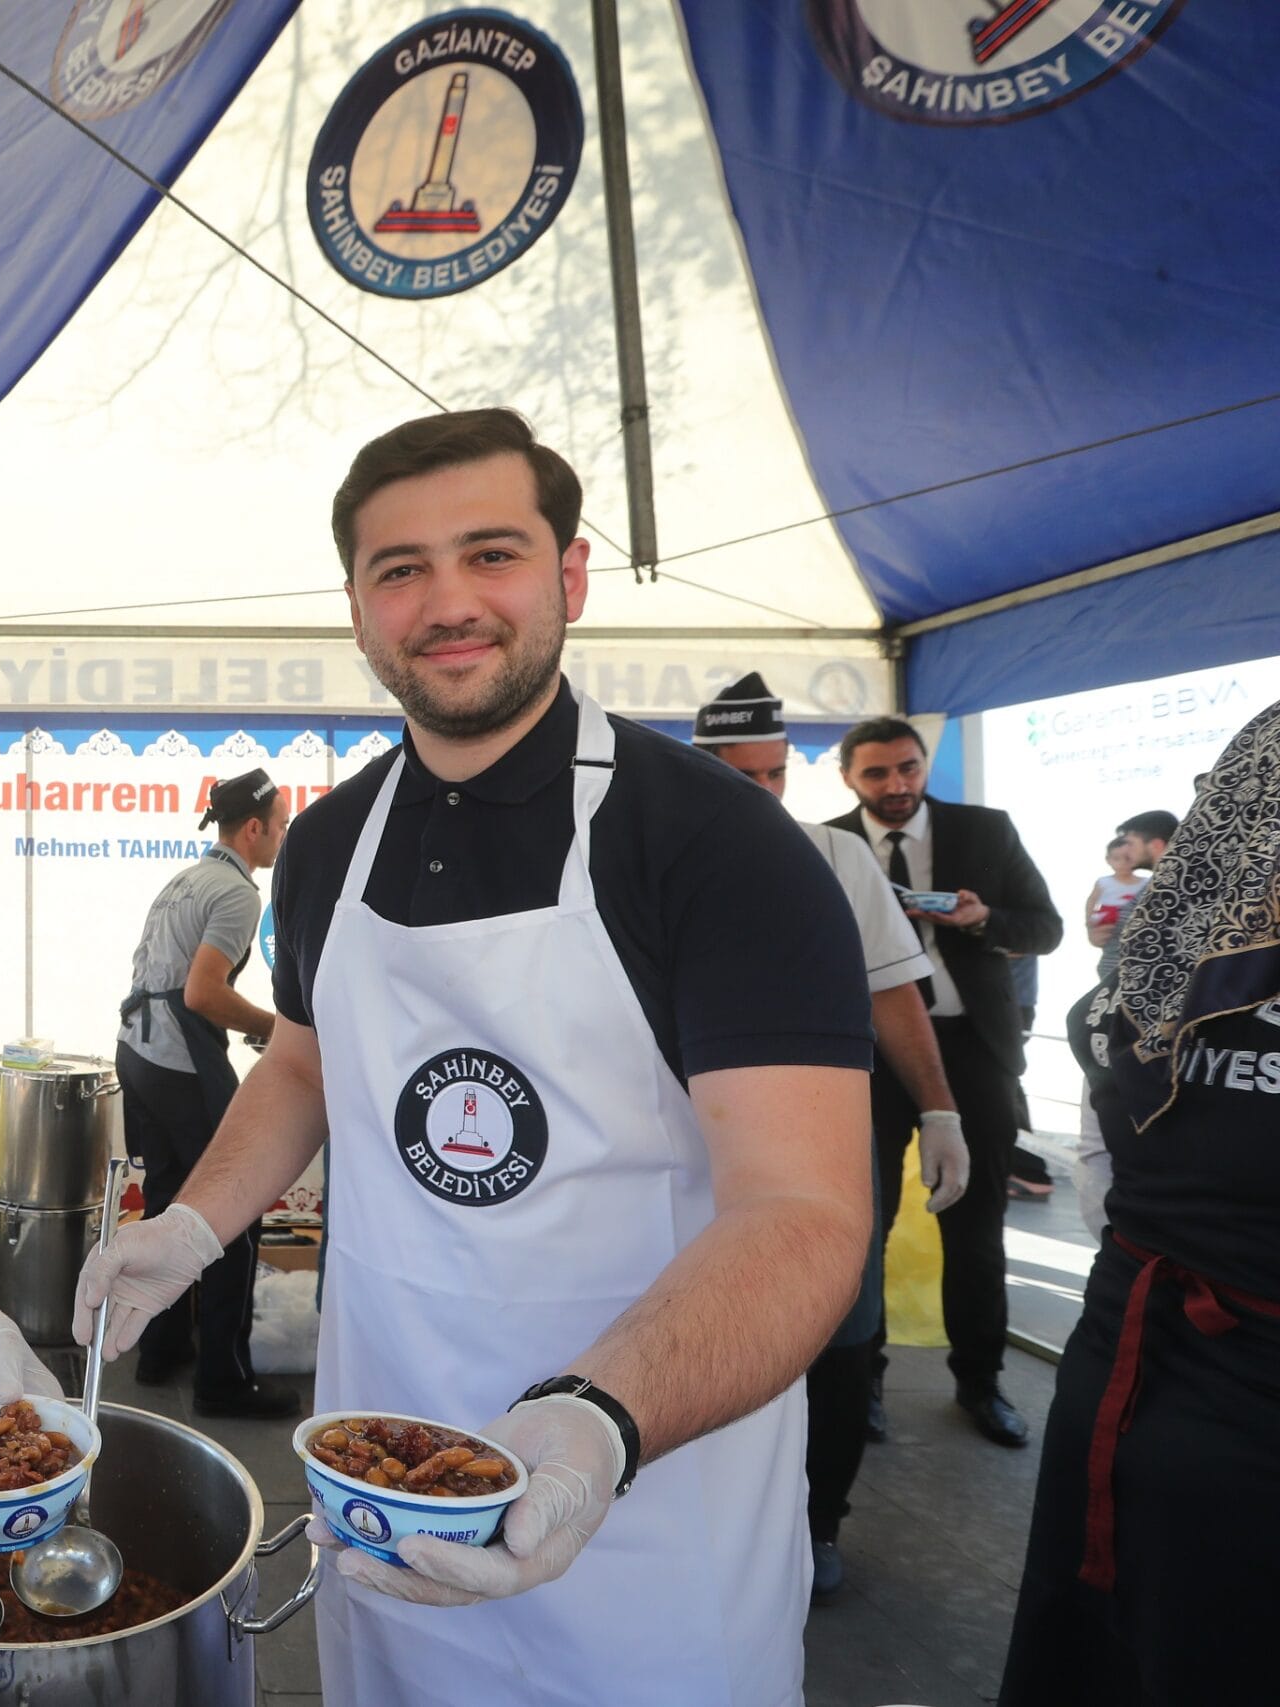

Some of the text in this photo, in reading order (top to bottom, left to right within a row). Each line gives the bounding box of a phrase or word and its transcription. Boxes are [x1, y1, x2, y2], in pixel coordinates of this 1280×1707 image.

[394, 23, 537, 75] GAZİANTEP
[413, 164, 565, 290] BELEDİYESİ
[15, 837, 111, 857] Mehmet
[415, 1054, 531, 1109] ŞAHİNBEY
[406, 1141, 535, 1198] BELEDİYESİ
